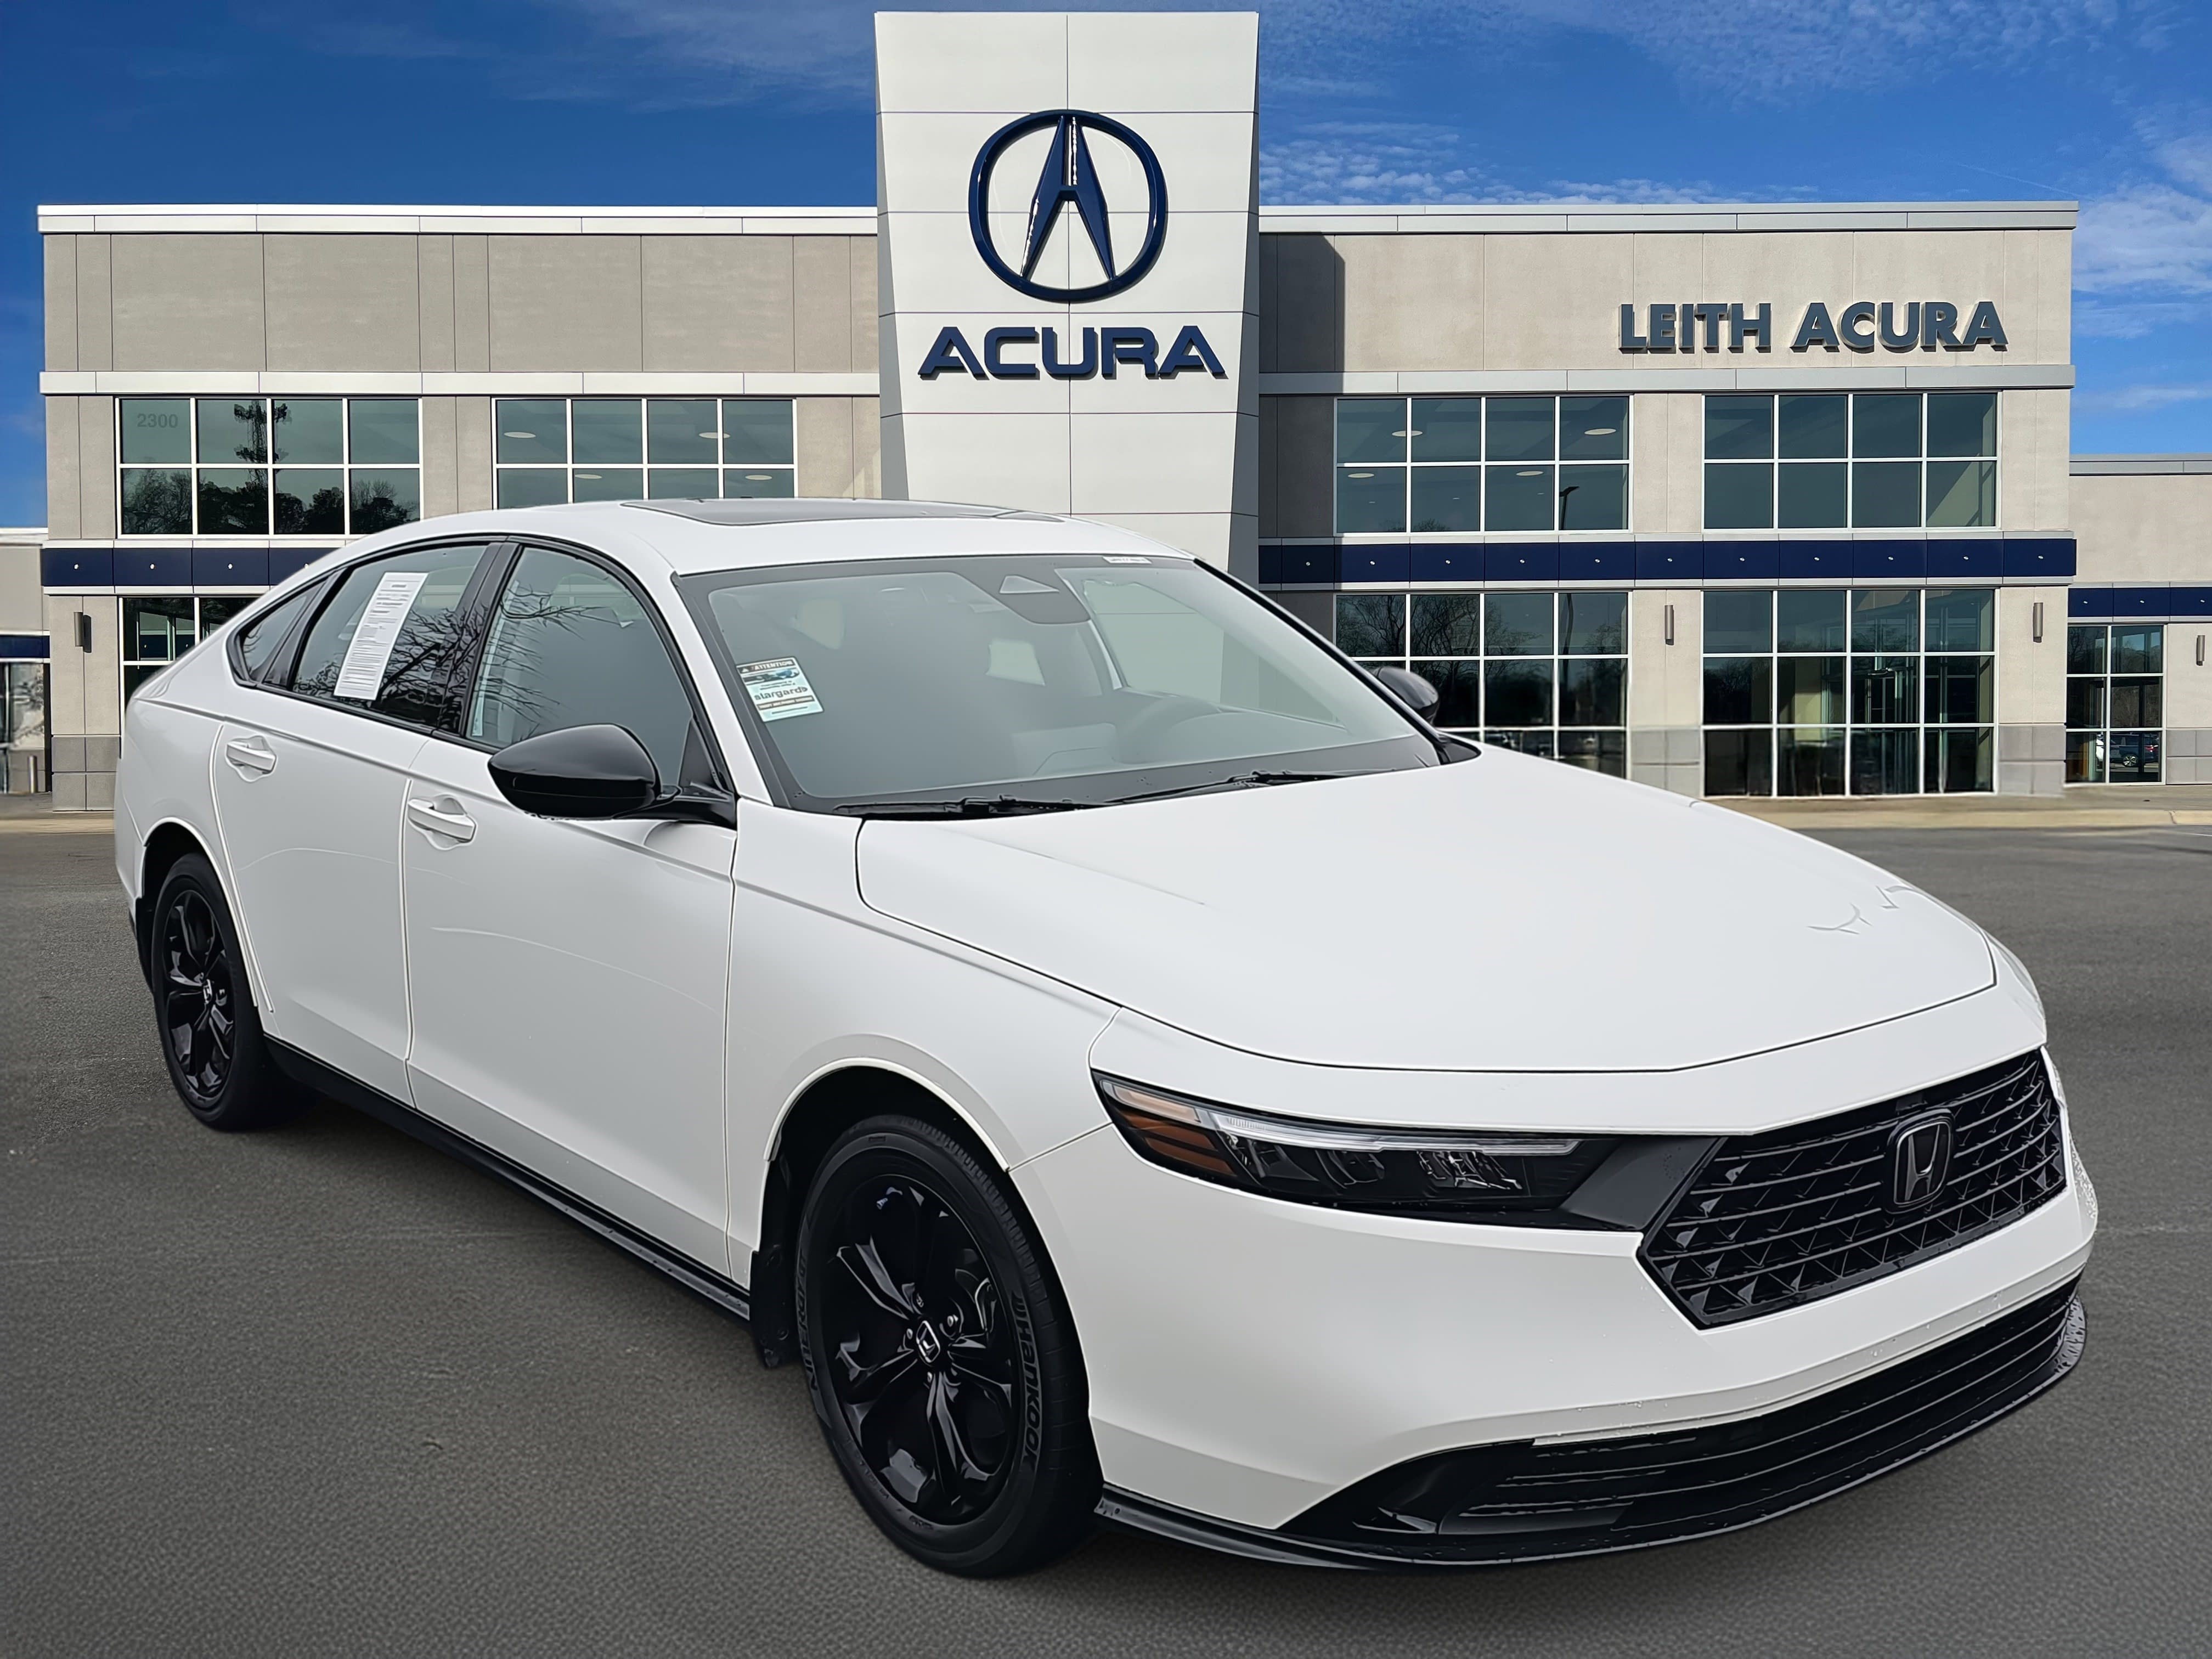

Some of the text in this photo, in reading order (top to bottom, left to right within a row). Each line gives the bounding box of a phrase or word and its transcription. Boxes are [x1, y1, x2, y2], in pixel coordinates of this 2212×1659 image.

[917, 325, 1229, 380] ACURA
[1618, 301, 2009, 354] LEITH ACURA
[137, 413, 179, 428] 2300
